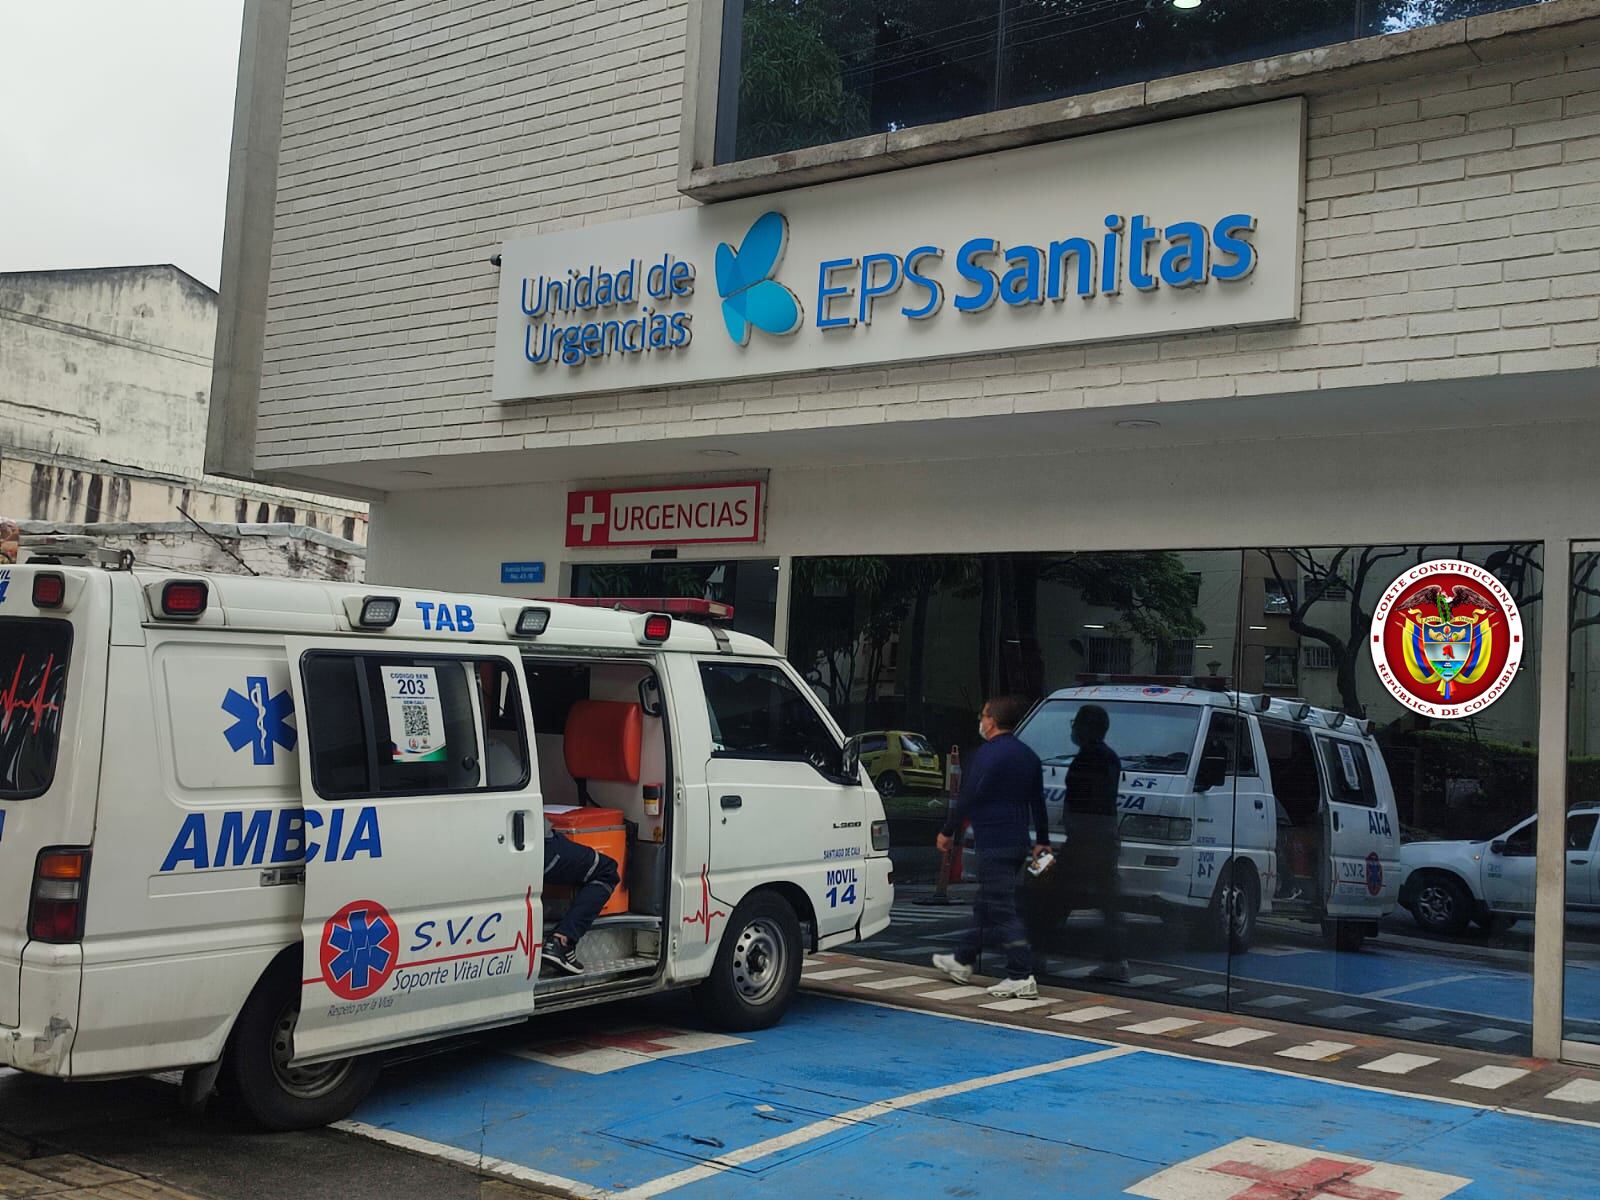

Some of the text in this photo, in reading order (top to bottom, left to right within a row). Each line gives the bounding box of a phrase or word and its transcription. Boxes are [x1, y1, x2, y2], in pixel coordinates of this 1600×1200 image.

[521, 252, 692, 318] Unidad de
[815, 213, 1256, 329] EPS Sanitas
[524, 306, 690, 366] Urgencias
[613, 499, 749, 532] URGENCIAS
[415, 601, 475, 633] TAB
[397, 679, 426, 695] 203
[826, 867, 858, 886] MOVIL
[825, 884, 857, 909] 14
[392, 954, 513, 994] Soporte Vital Cali
